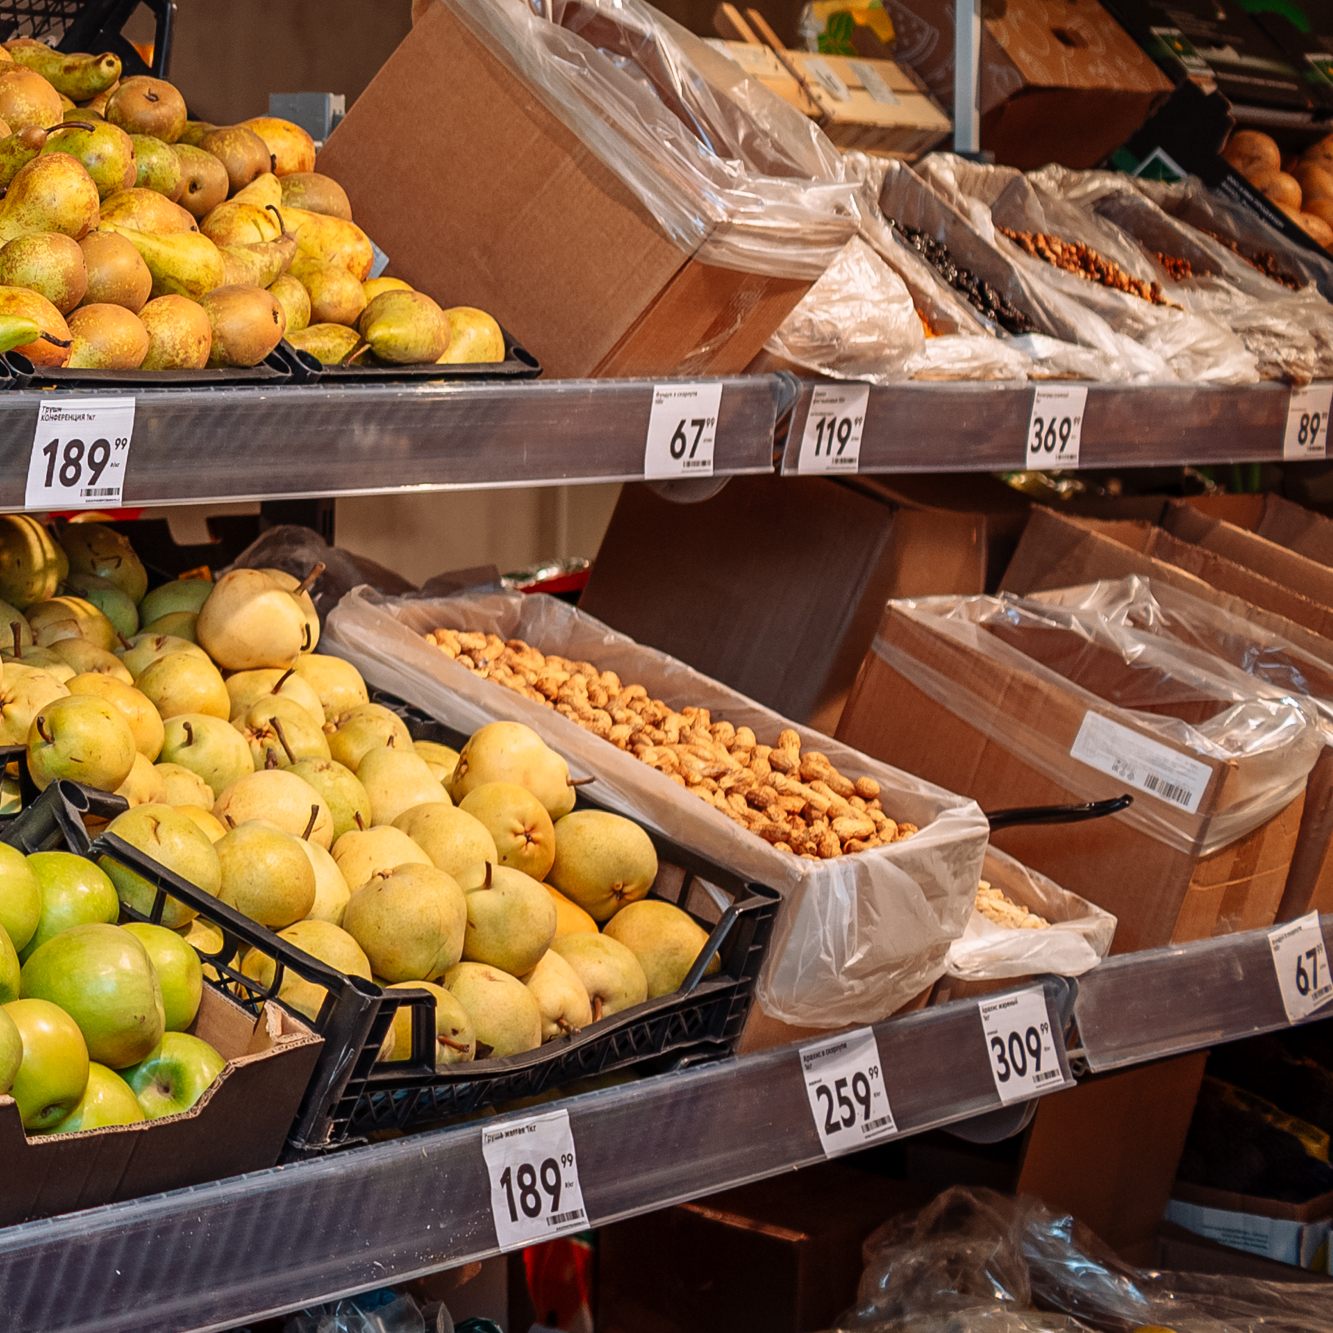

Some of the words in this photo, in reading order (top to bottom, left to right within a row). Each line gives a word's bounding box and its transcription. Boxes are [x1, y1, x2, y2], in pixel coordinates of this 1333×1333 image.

[669, 418, 706, 460] 67
[814, 416, 852, 456] 119
[1030, 416, 1071, 453] 369
[1297, 412, 1321, 445] 89
[42, 438, 111, 488] 189
[114, 437, 128, 450] 99
[1295, 947, 1318, 996] 67
[990, 1026, 1042, 1083] 309
[816, 1071, 871, 1135] 259
[868, 1065, 879, 1080] 99
[500, 1157, 562, 1223] 189
[561, 1153, 574, 1168] 99
